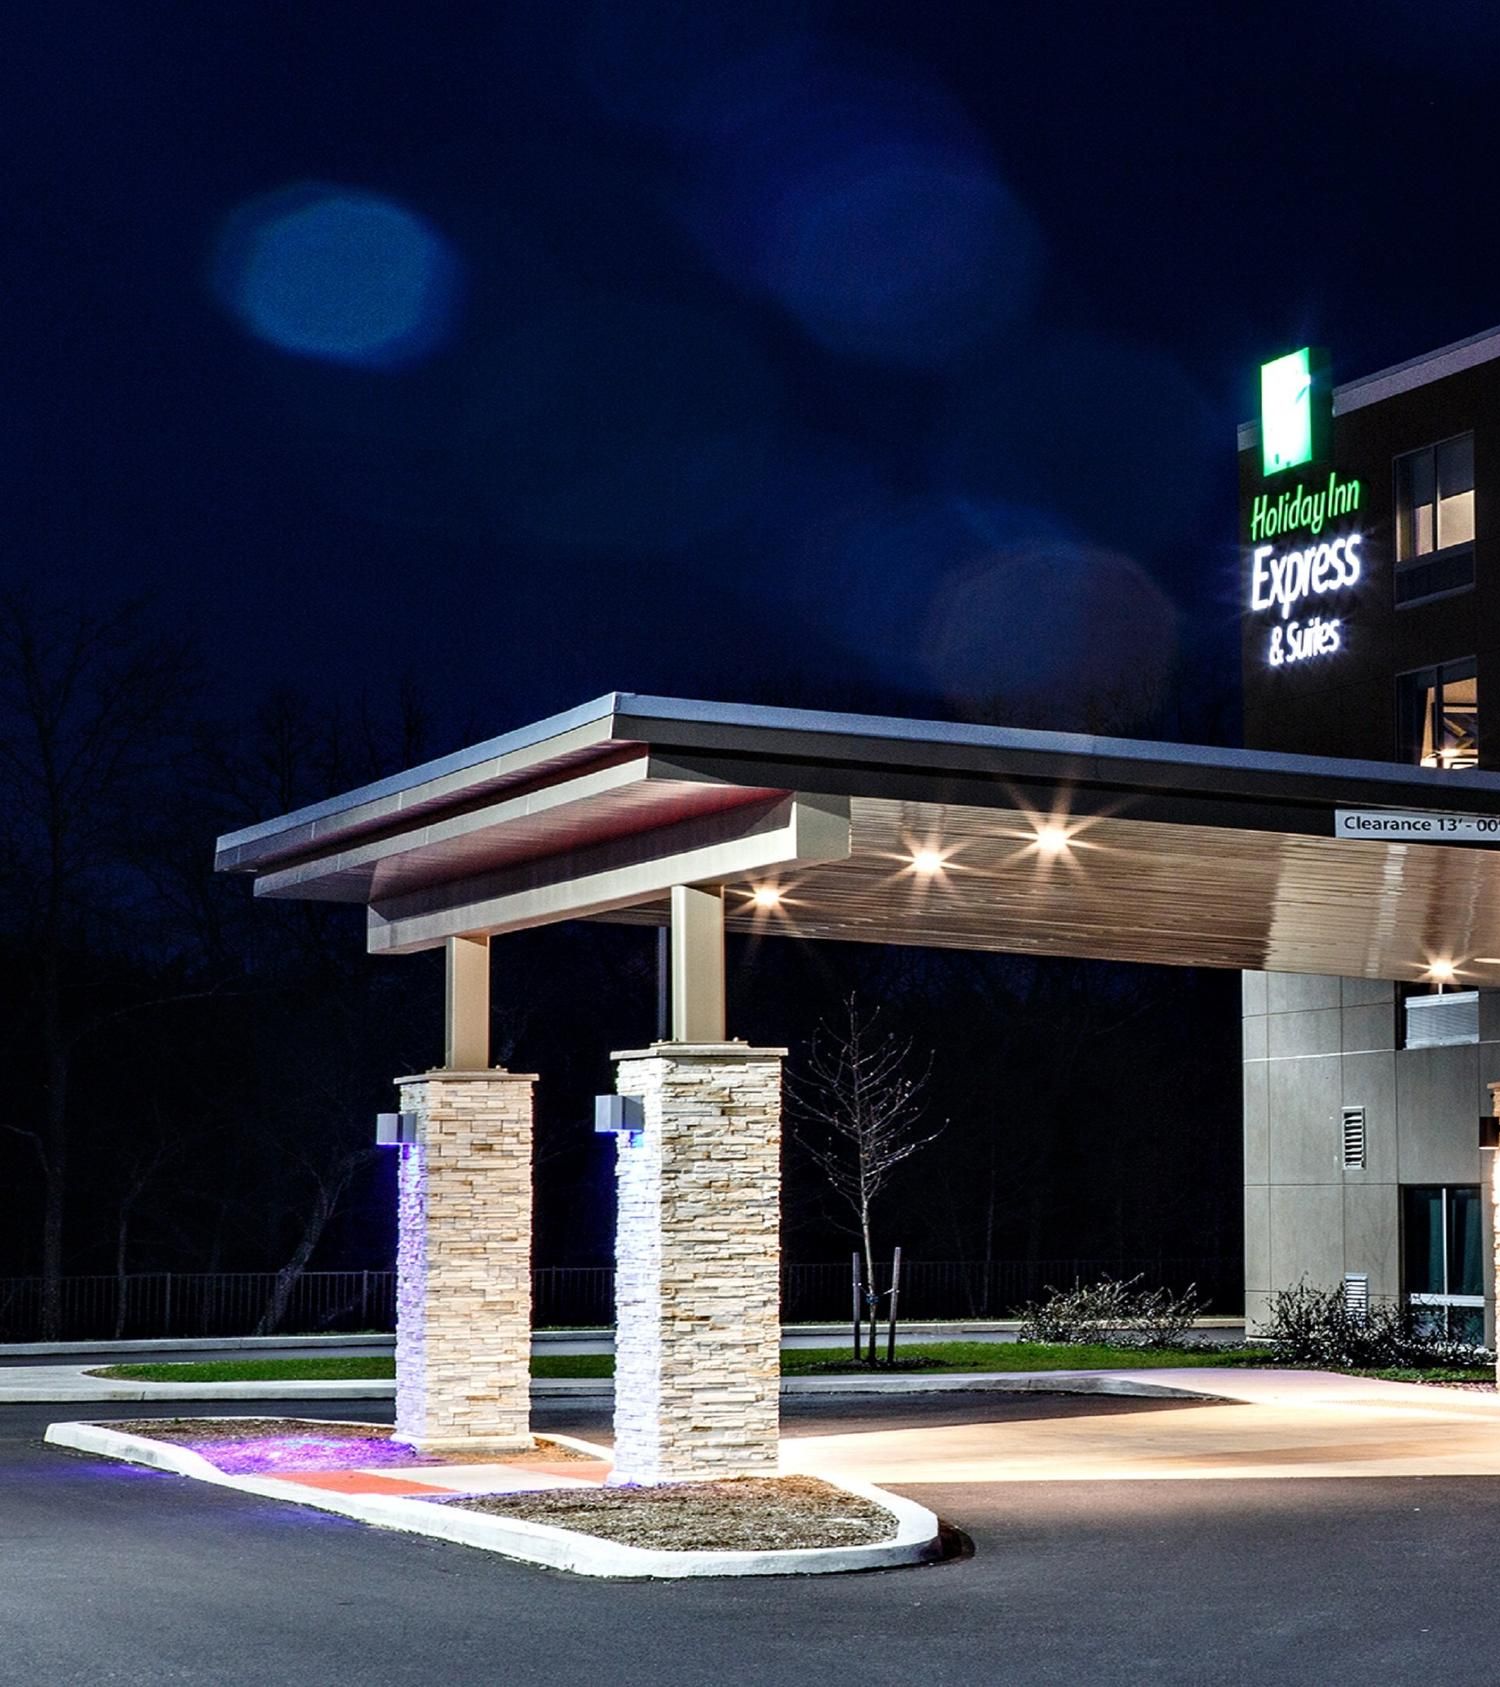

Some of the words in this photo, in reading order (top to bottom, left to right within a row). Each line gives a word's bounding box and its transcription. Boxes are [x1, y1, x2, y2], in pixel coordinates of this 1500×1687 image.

[1251, 484, 1326, 541] Holiday
[1328, 472, 1360, 518] Inn
[1251, 535, 1361, 619] Express
[1269, 626, 1284, 666] &
[1286, 617, 1340, 662] Suites
[1344, 816, 1432, 831] Clearance
